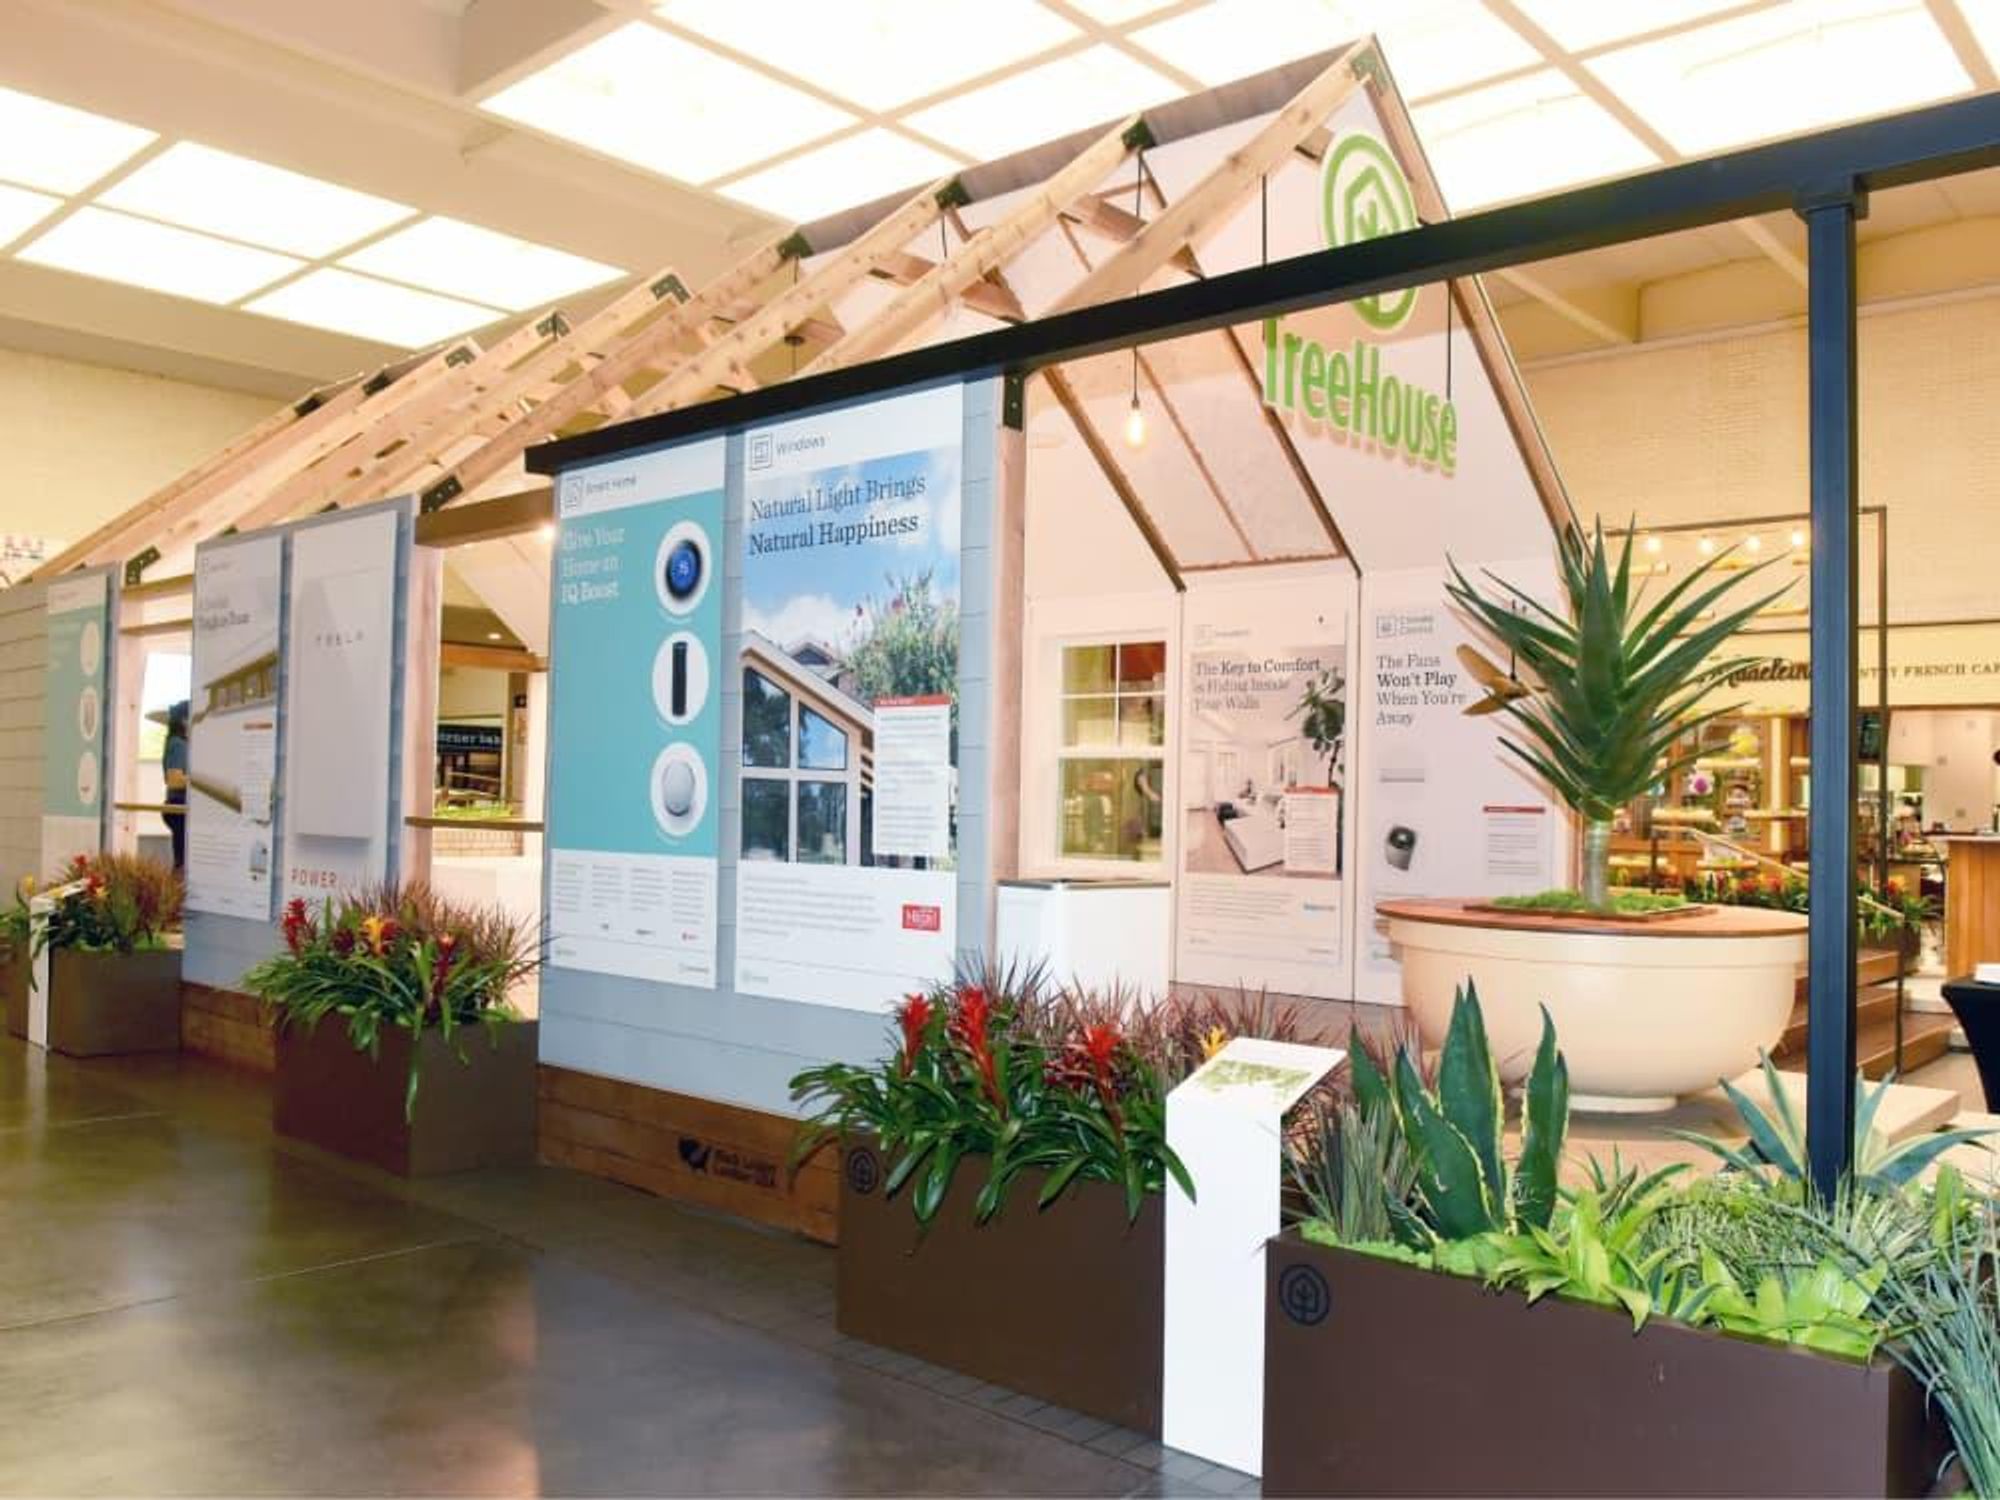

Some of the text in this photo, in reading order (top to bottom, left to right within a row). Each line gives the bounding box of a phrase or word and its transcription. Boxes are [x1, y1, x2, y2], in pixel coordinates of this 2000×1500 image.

[1264, 317, 1457, 469] TreeHouse
[776, 435, 826, 454] Windows
[751, 475, 927, 521] Natural Light Brings
[749, 515, 919, 556] Natural Happiness
[580, 580, 619, 602] Boost
[1197, 657, 1320, 678] The Key to Comfort
[1376, 655, 1403, 669] The
[1903, 664, 1966, 678] FRENCH
[1377, 671, 1457, 688] Won't Play
[1377, 691, 1418, 705] When
[1376, 710, 1413, 727] Away
[291, 868, 337, 889] POWER
